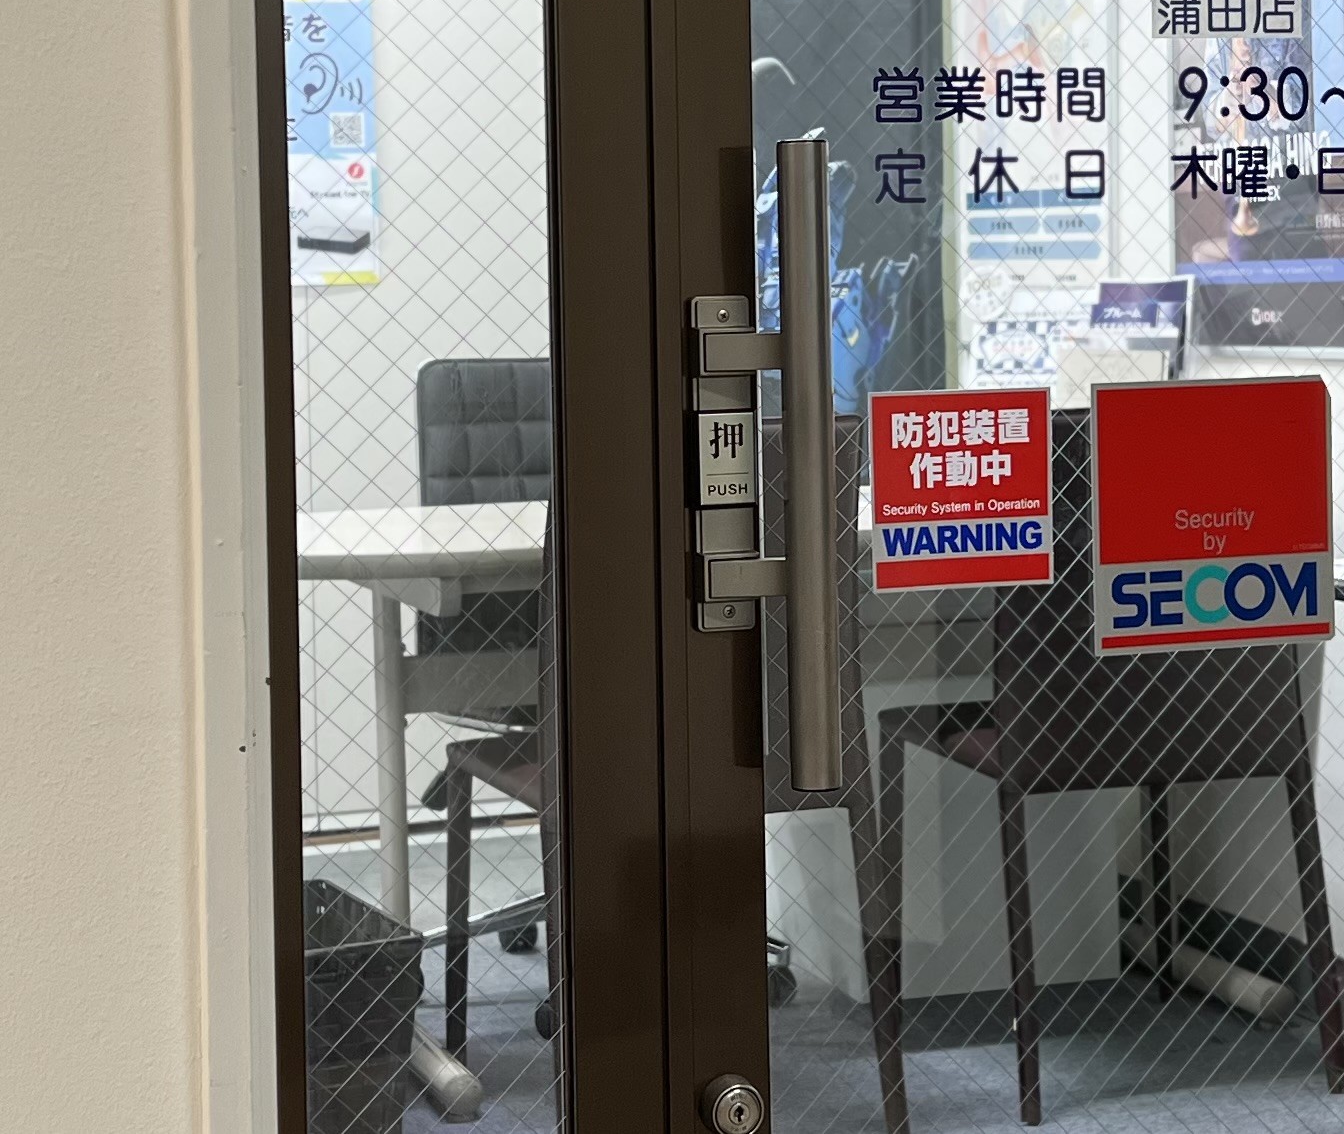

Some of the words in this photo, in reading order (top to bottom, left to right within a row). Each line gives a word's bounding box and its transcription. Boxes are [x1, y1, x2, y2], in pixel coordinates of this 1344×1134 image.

[872, 66, 1107, 124] 営業時間
[709, 421, 744, 460] 押
[891, 408, 1031, 449] 防犯装置
[909, 449, 1013, 490] 作動中
[707, 483, 748, 497] PUSH
[882, 502, 928, 517] Security
[931, 500, 972, 515] System
[974, 499, 985, 512] in
[987, 497, 1041, 512] Operation
[1174, 506, 1256, 531] Security
[882, 520, 1043, 558] WARNING
[1203, 532, 1227, 555] by
[1111, 561, 1318, 630] SECOM
